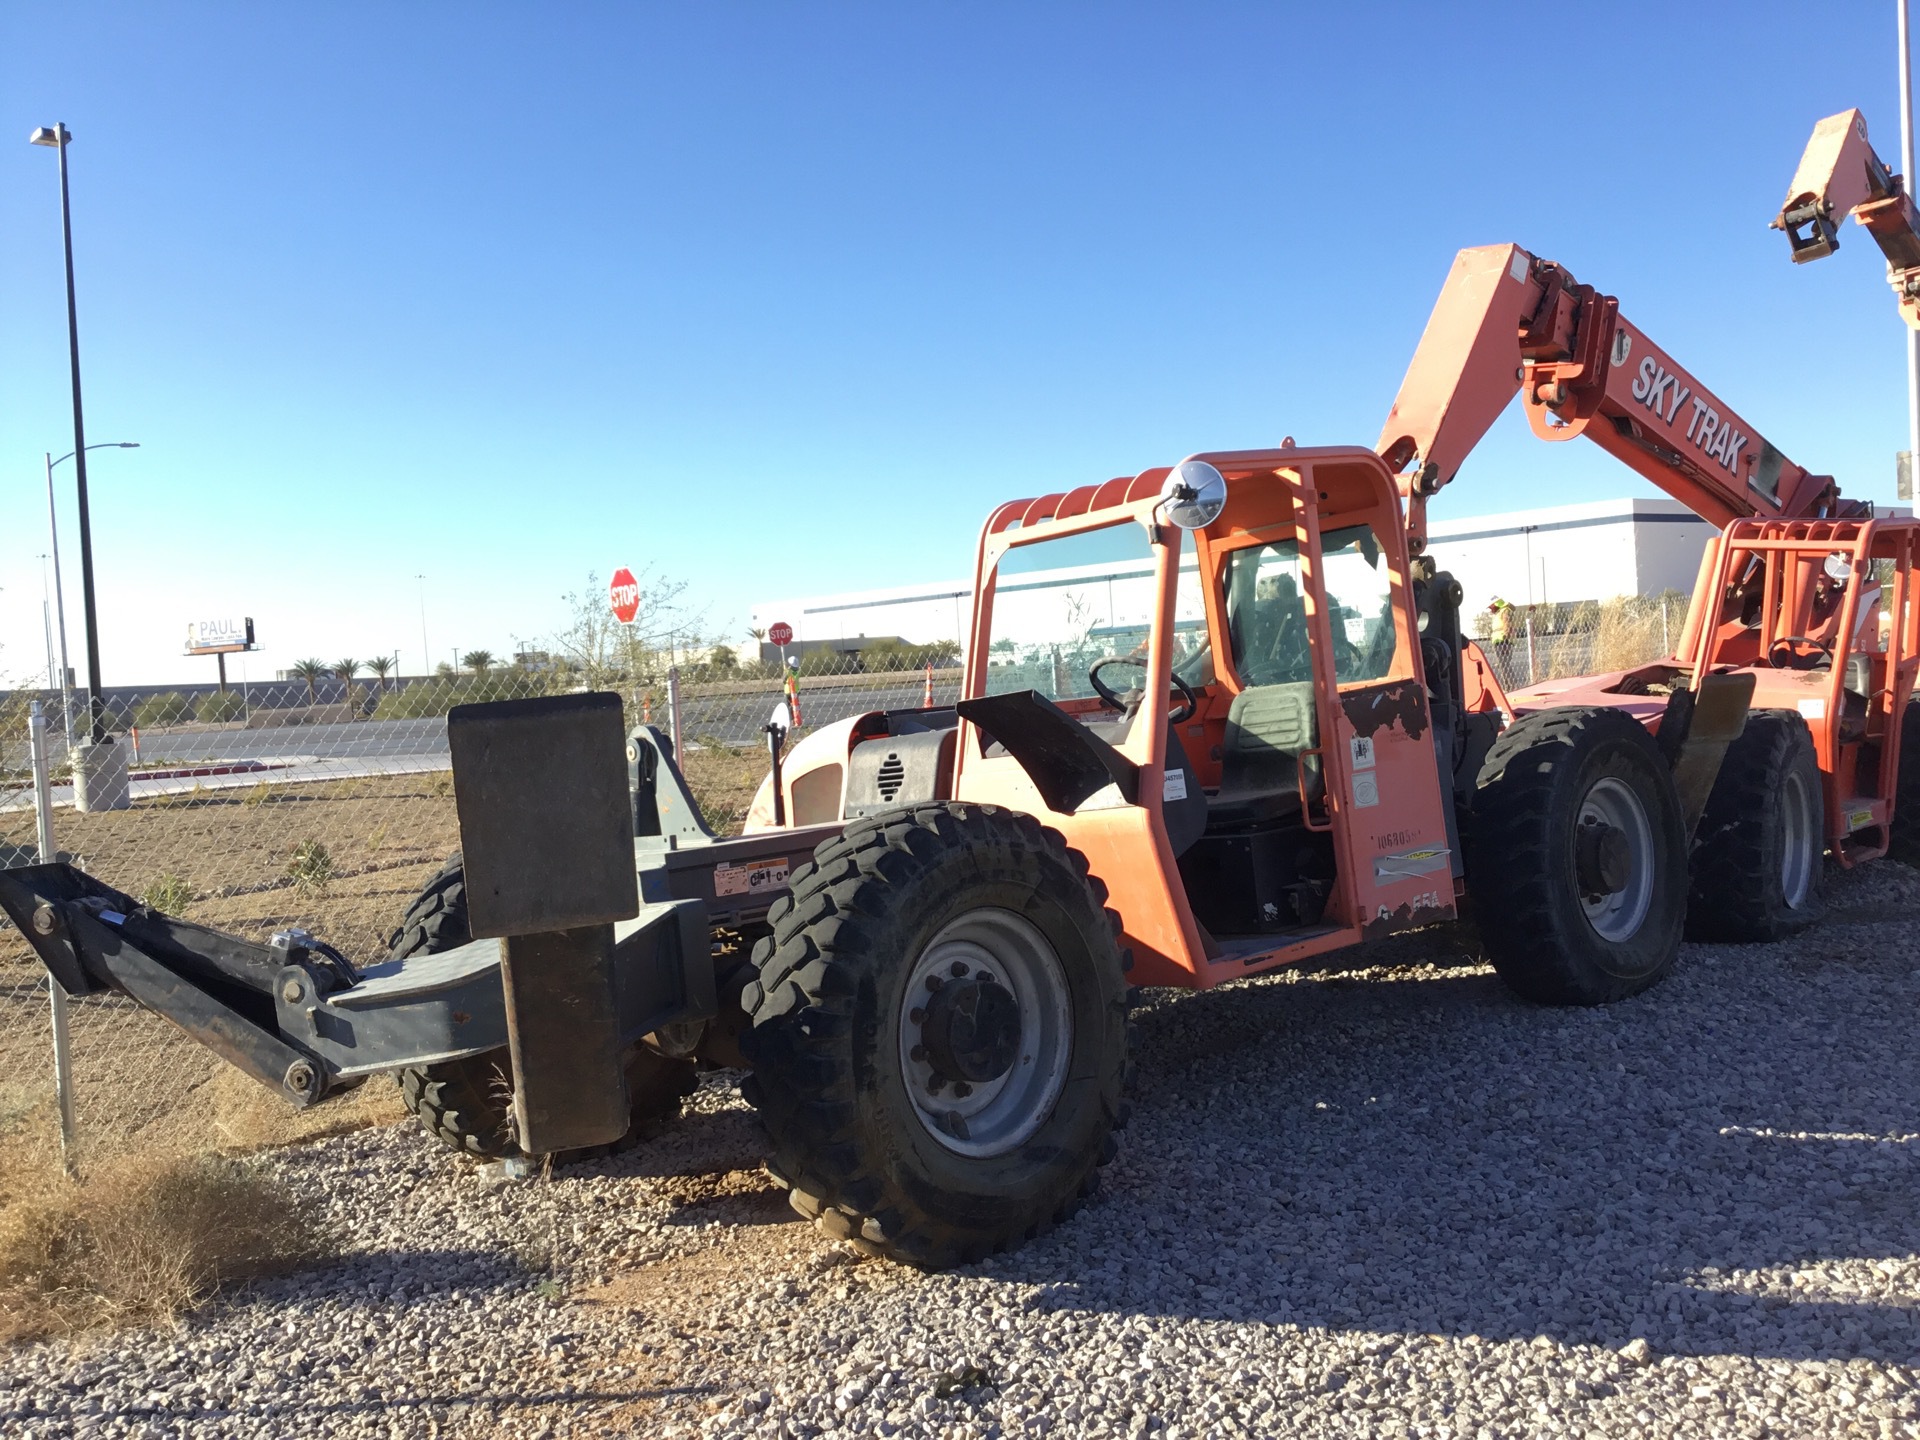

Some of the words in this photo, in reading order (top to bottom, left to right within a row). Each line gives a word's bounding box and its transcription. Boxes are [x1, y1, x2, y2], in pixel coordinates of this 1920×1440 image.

[1632, 356, 1690, 426] SKY
[1686, 396, 1748, 476] TRAK
[612, 584, 637, 607] STOP
[770, 628, 792, 640] STOP
